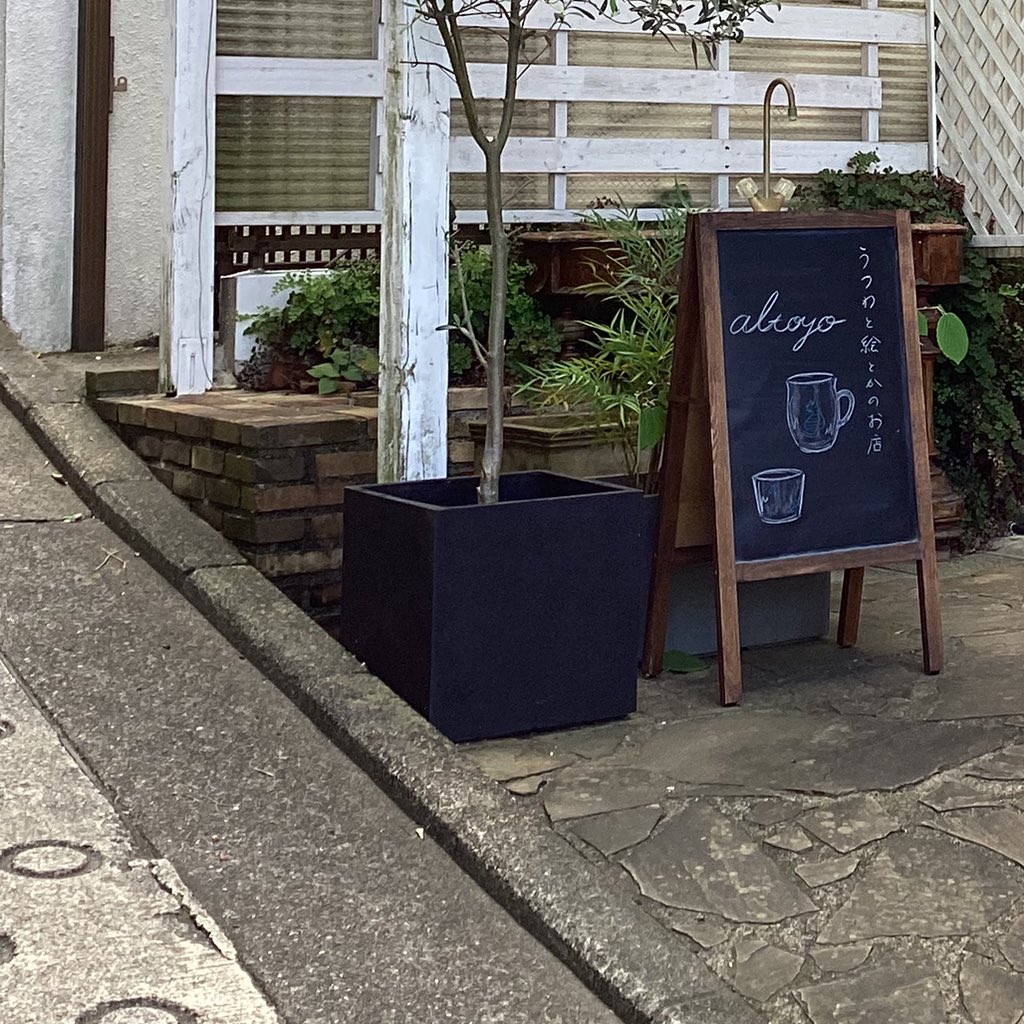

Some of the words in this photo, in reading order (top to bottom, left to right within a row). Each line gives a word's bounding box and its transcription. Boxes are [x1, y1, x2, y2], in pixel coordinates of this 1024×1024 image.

[729, 290, 847, 352] altoyo
[859, 246, 883, 455] うつわと絵とかのお店
